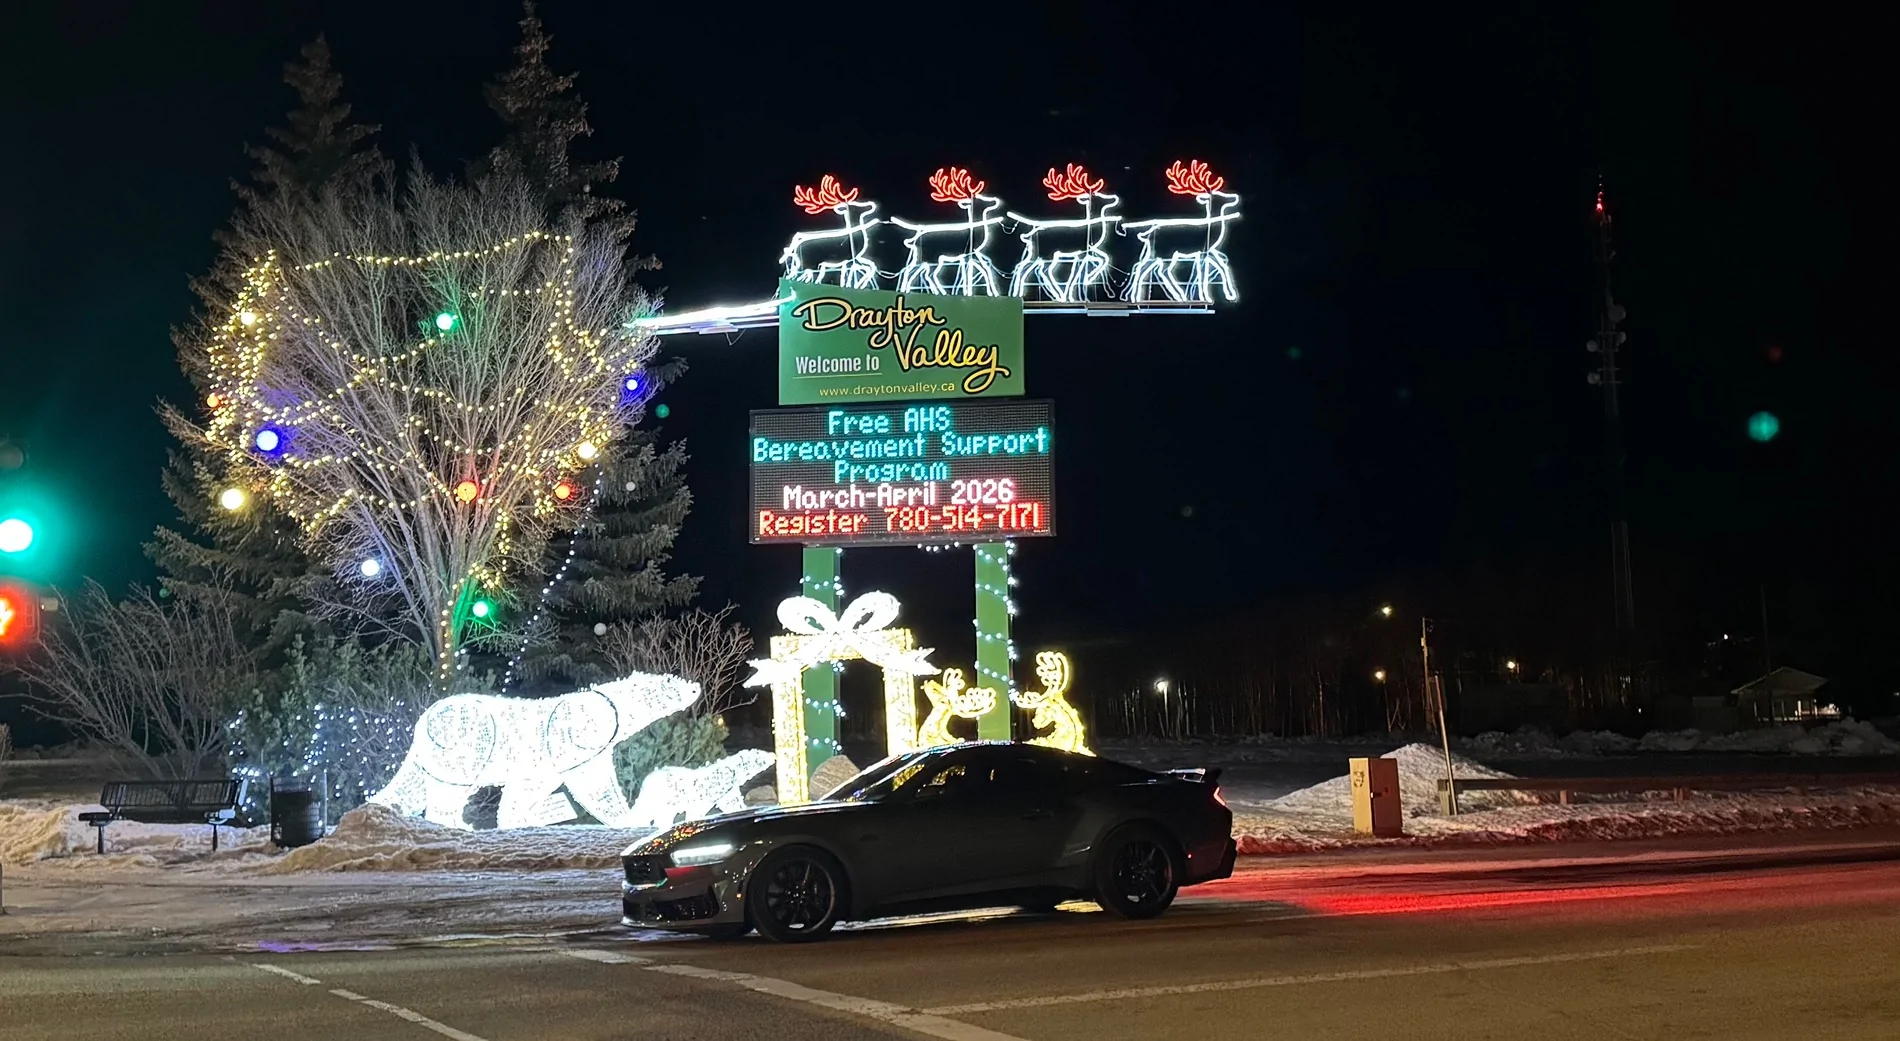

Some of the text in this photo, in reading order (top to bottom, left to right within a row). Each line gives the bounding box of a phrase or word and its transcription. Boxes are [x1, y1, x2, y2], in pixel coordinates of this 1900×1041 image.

[794, 297, 945, 348] Drayton
[796, 355, 880, 374] Welcome to
[894, 323, 1009, 393] Valley
[819, 382, 955, 397] www.draytonvalley.ca
[828, 406, 951, 435] Free AHS
[753, 427, 1047, 462] Bereavement Support
[834, 459, 948, 484] Program
[783, 478, 1014, 510] March-April 2026
[759, 502, 1040, 535] Register 780-514-7171
